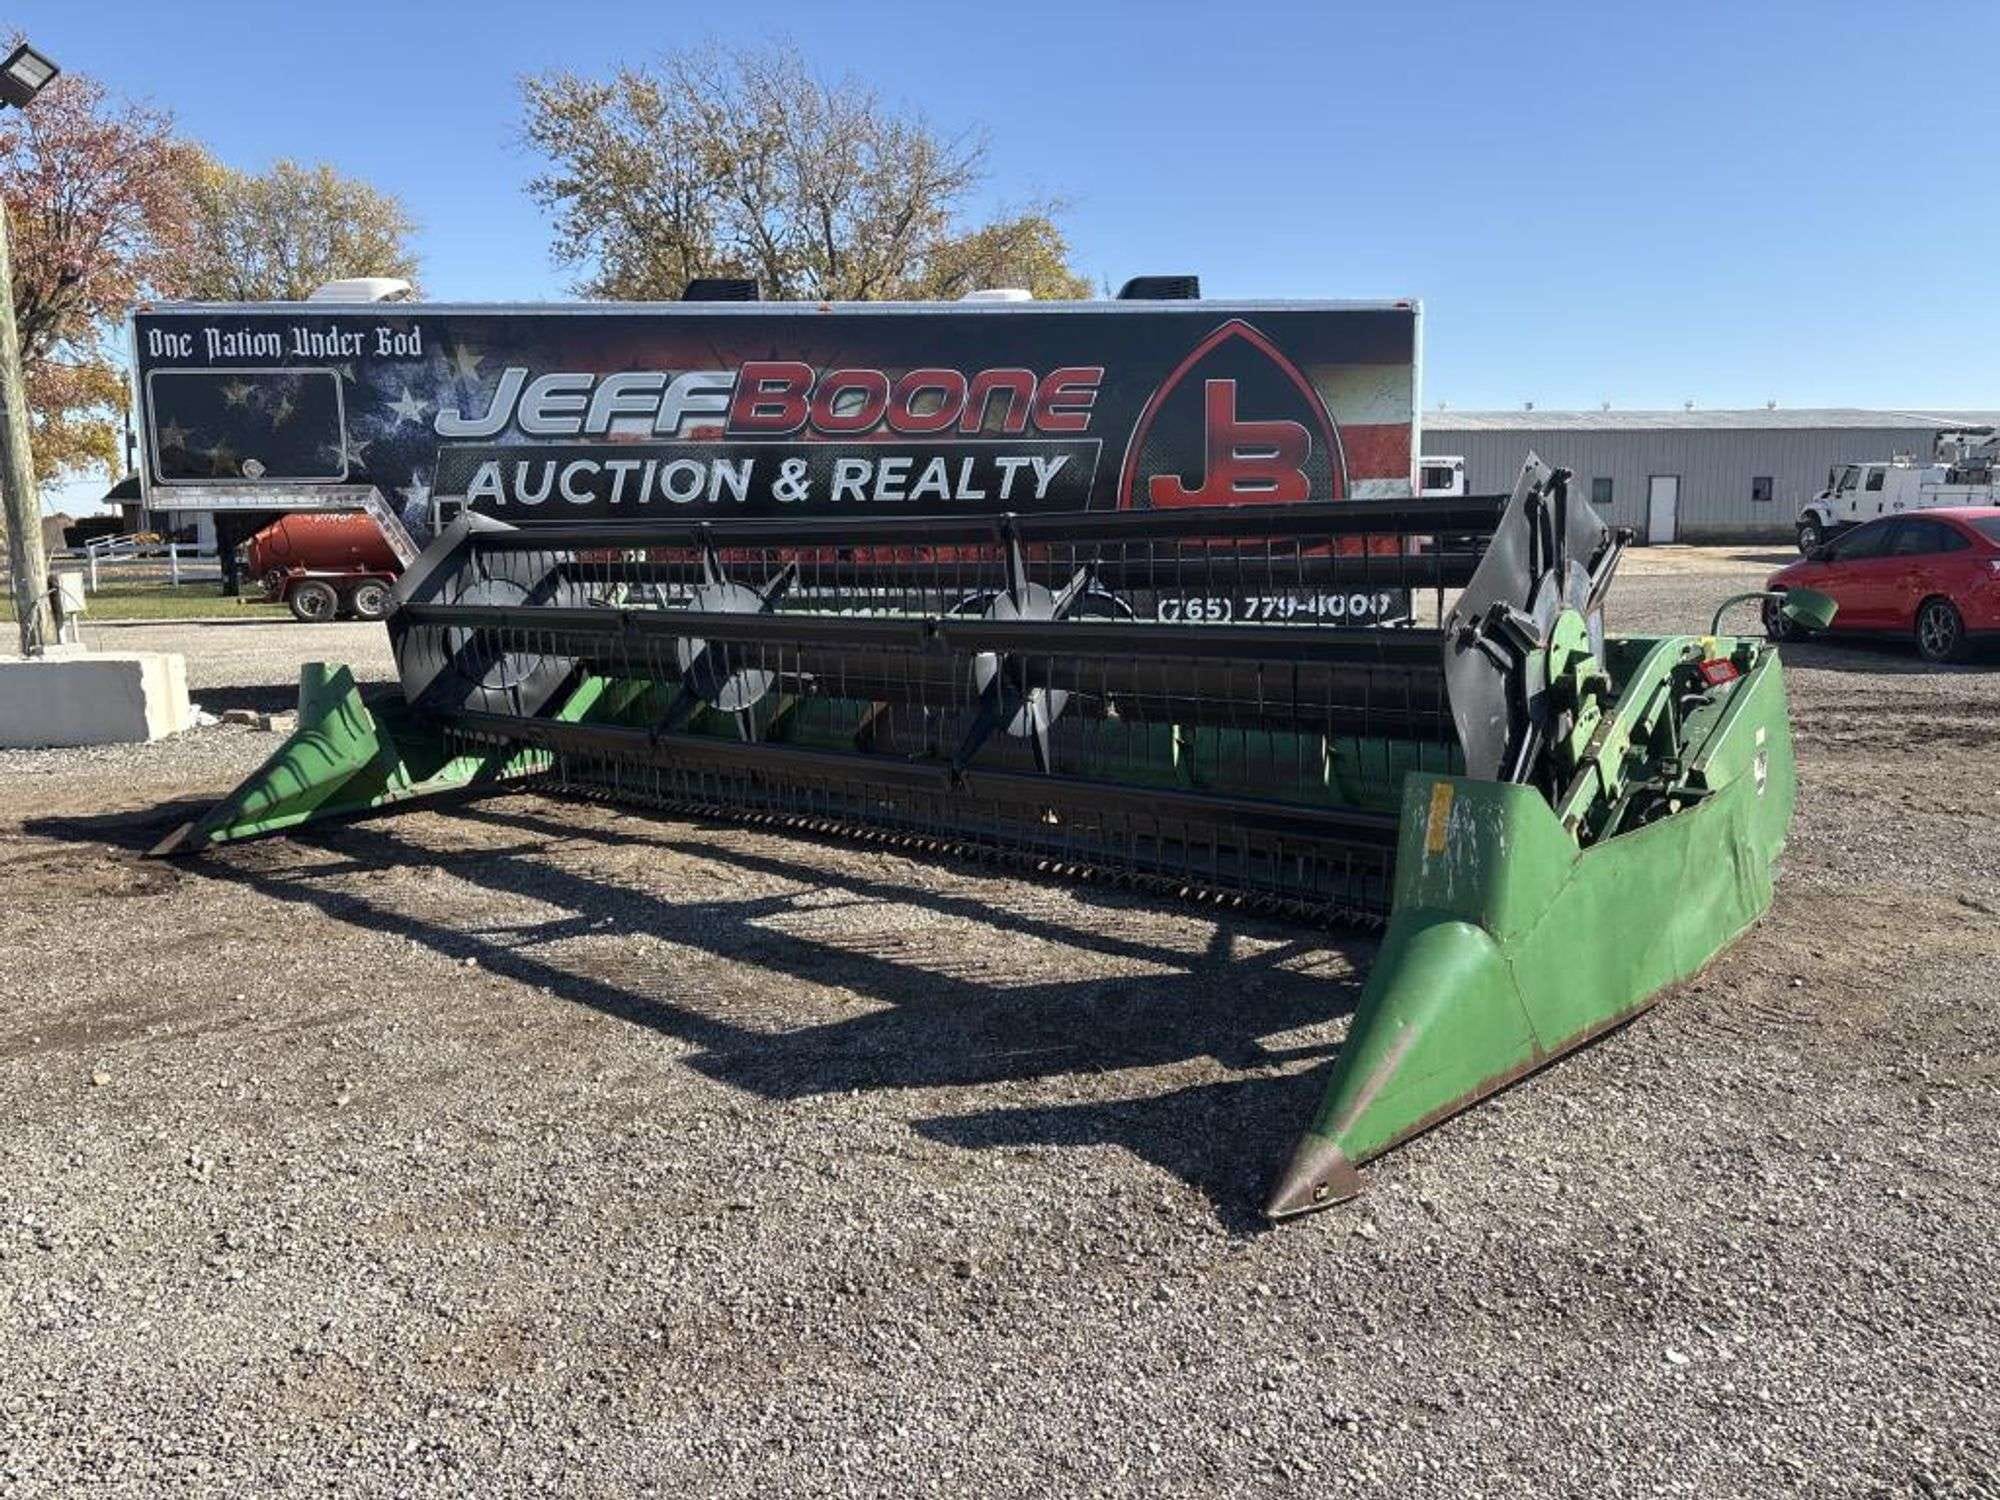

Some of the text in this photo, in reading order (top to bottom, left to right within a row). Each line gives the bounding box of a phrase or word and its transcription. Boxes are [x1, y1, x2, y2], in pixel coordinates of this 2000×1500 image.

[148, 325, 422, 364] One Nation Under God
[466, 455, 1070, 506] AUCTION & REALTY
[1157, 593, 1391, 624] (765) 779-4000
